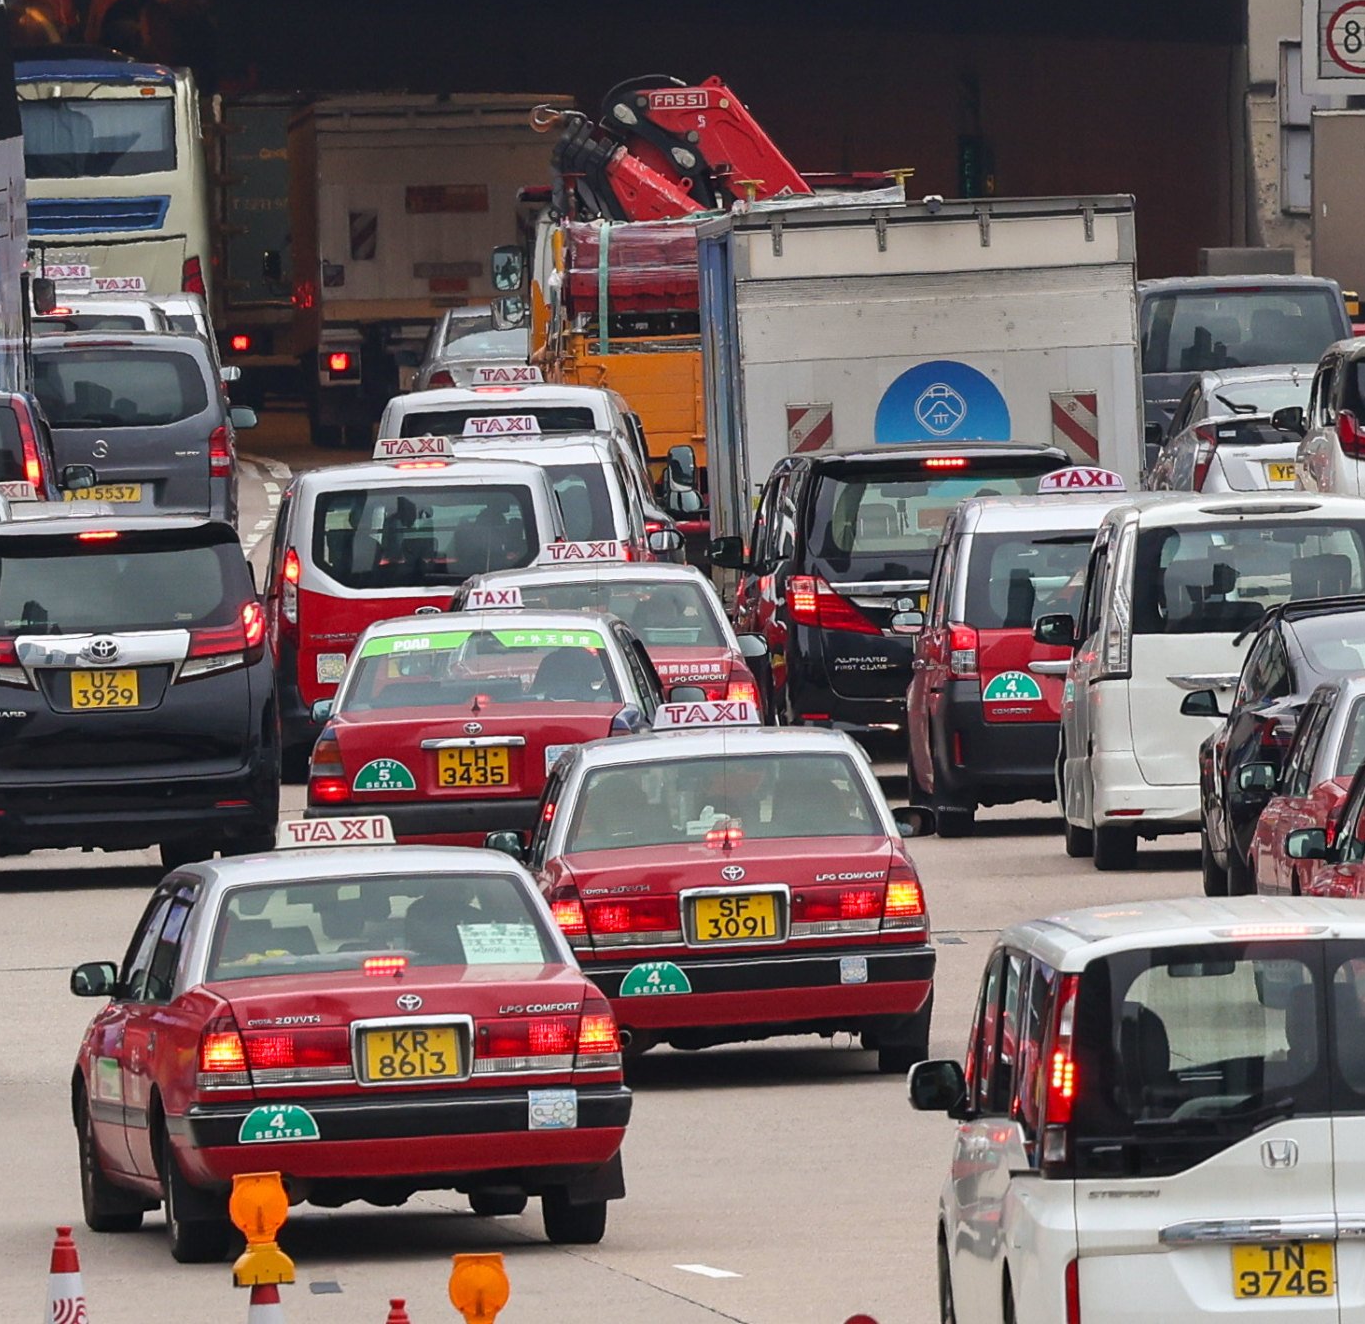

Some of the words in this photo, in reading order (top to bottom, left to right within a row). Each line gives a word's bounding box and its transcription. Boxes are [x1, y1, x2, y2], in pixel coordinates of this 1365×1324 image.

[655, 93, 706, 108] FASSI
[43, 266, 87, 277] TAXI
[95, 278, 141, 290] TAXI
[480, 367, 536, 381] TAXI
[470, 417, 532, 433] TAXI
[382, 438, 445, 455] TAXI
[1050, 470, 1114, 487] TAXI
[101, 484, 137, 502] 5537
[546, 542, 617, 559] TAXI
[472, 589, 517, 605] TAXI
[90, 672, 118, 690] UZ
[1000, 673, 1024, 681] TAXI
[1005, 679, 1018, 692] 4
[77, 688, 134, 707] 3929
[664, 702, 749, 724] TAXI
[371, 760, 397, 769] TAXI
[458, 748, 489, 767] LH
[378, 768, 391, 781] 5
[442, 765, 505, 785] 3435
[365, 780, 403, 789] SEATS
[288, 818, 384, 843] TAXI
[816, 872, 837, 881] LPG
[838, 869, 886, 880] COMFORT
[718, 897, 751, 918] SF
[708, 916, 767, 939] 3091
[637, 962, 671, 971] TAXI
[646, 970, 661, 985] 4
[634, 982, 677, 995] SEATS
[499, 1004, 524, 1014] LPG
[526, 1001, 579, 1014] COMFORT
[391, 1031, 429, 1054] KR
[378, 1050, 447, 1078] 8613
[269, 1113, 286, 1129] 4
[254, 1127, 303, 1140] SEATS
[1260, 1245, 1305, 1271] TN
[1239, 1268, 1328, 1297] 3746
